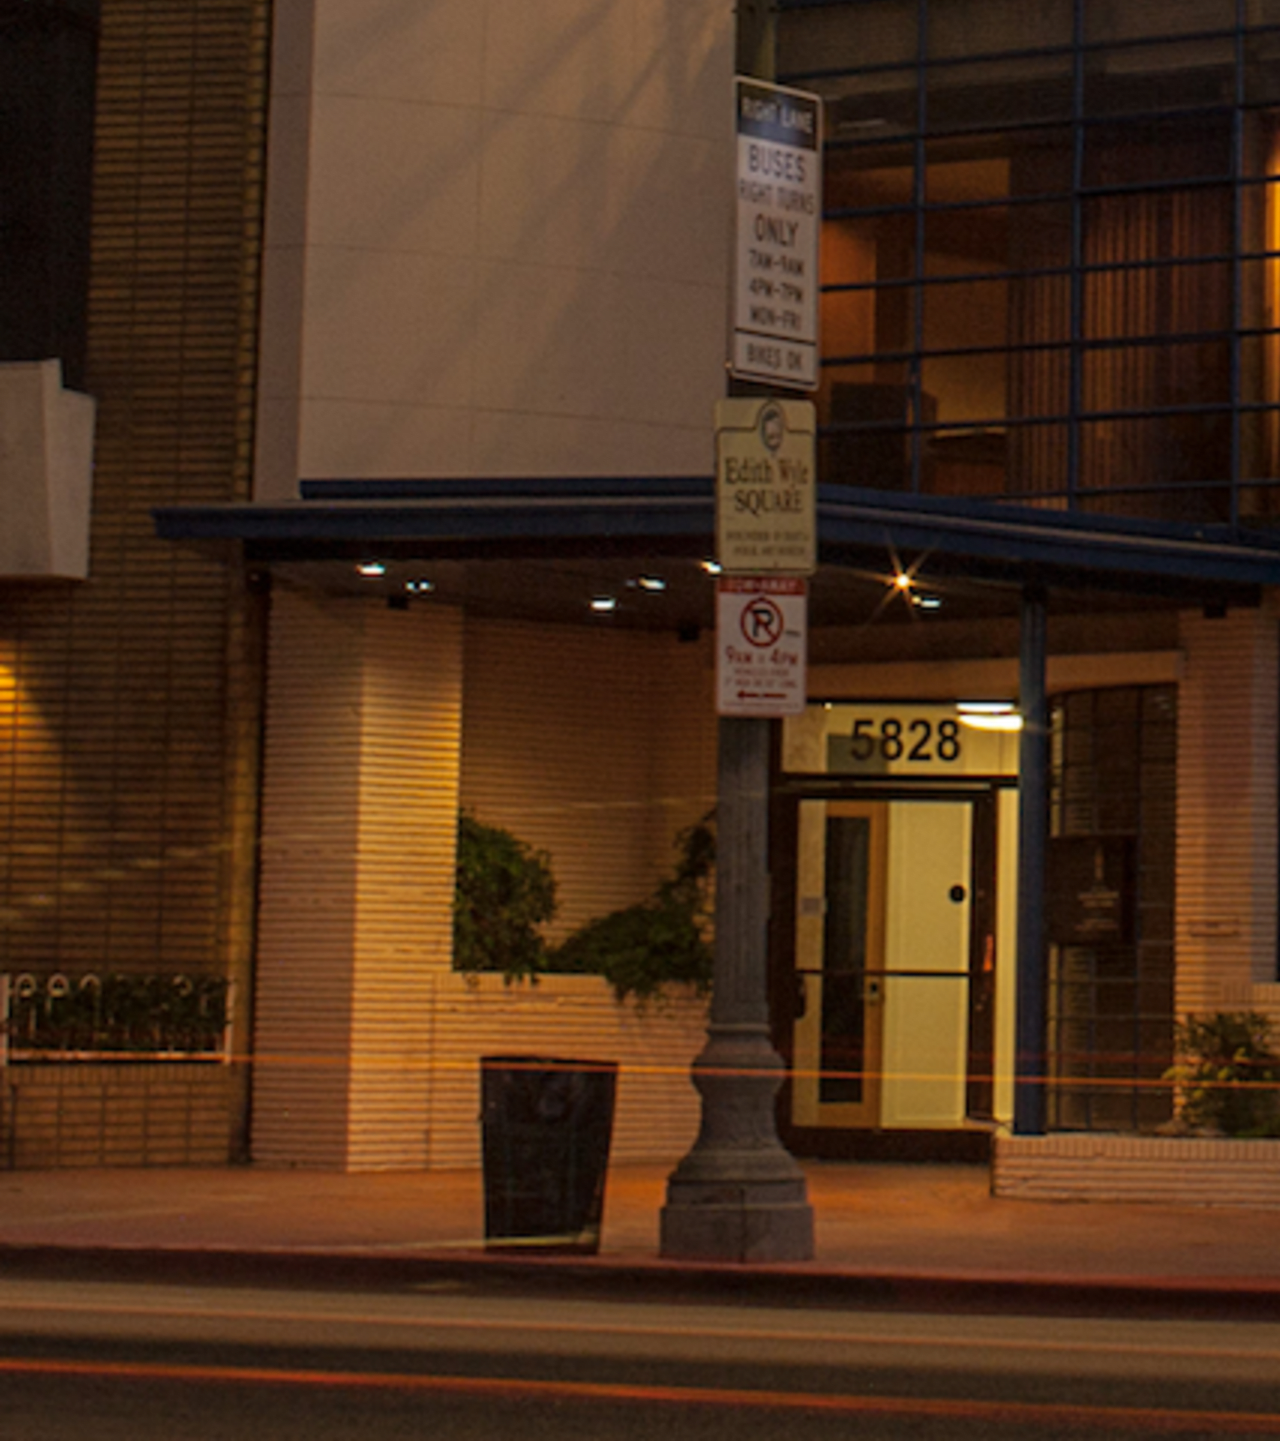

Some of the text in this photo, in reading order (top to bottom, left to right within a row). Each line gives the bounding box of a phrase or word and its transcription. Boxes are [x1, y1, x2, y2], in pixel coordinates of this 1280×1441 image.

[741, 95, 814, 135] RIGHT LANE
[748, 143, 806, 183] BUSES
[740, 177, 815, 216] RIGHT TURNS
[754, 212, 799, 248] ONLY
[749, 248, 805, 277] 7AM-9AM
[747, 341, 803, 372] BIKES OK
[725, 456, 773, 485] Edith
[734, 489, 804, 518] SQUARE
[850, 719, 960, 762] 5828
